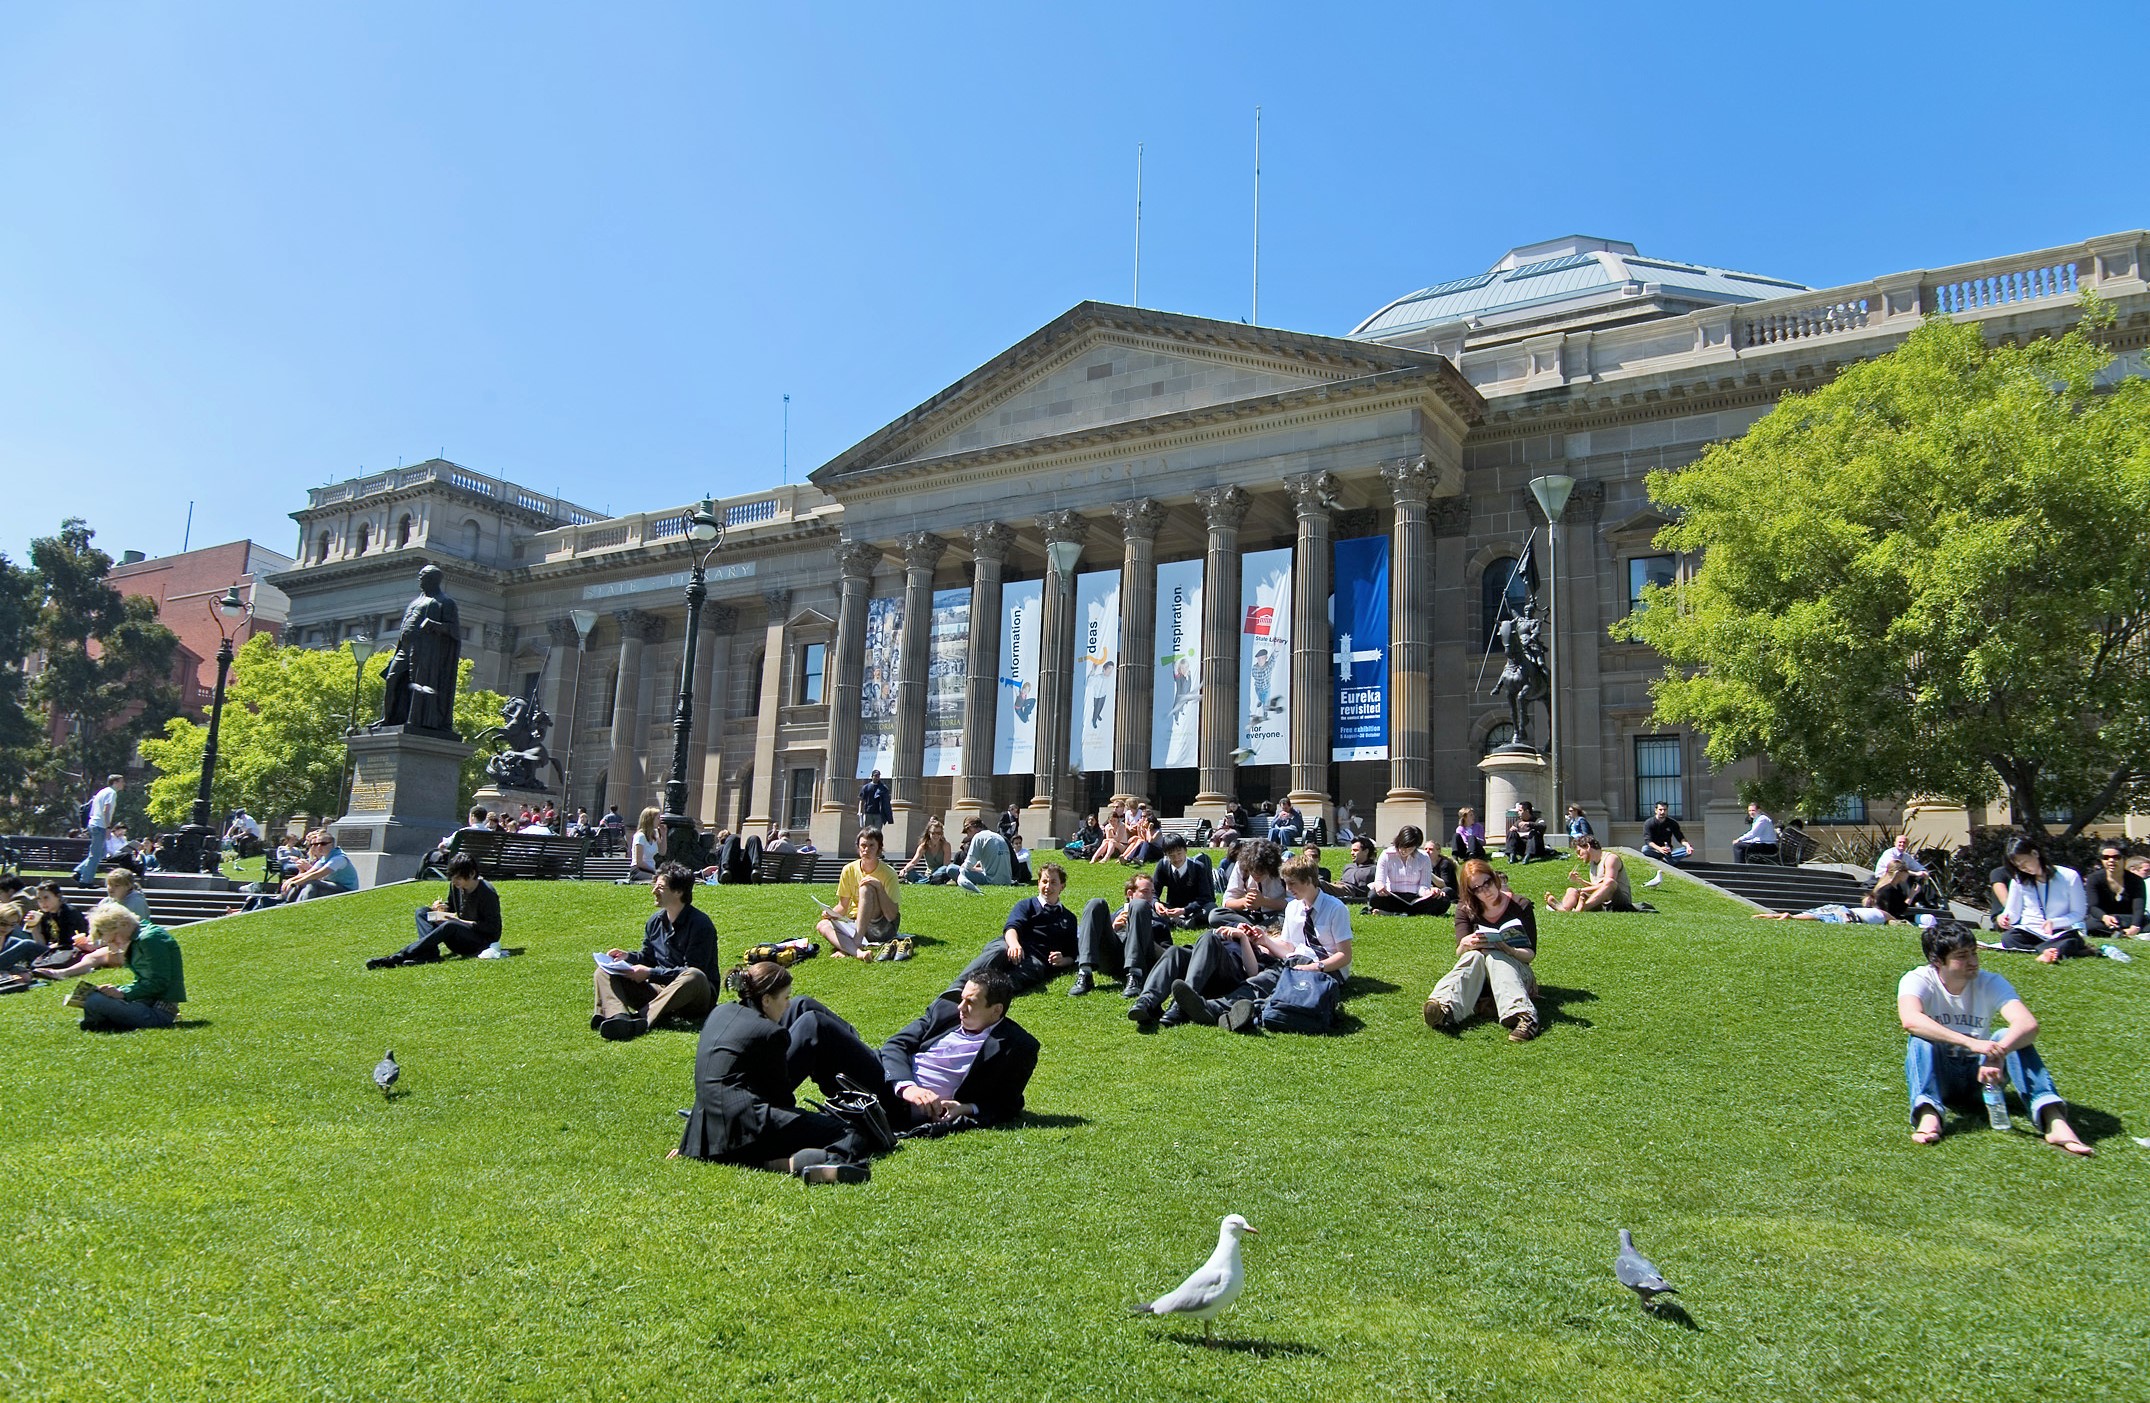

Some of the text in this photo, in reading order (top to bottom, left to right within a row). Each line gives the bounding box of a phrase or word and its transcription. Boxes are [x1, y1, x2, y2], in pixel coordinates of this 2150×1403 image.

[1340, 690, 1381, 704] Eureka
[1340, 703, 1381, 715] revisited
[929, 719, 961, 727] VICTORIA
[1246, 732, 1283, 740] everyone.
